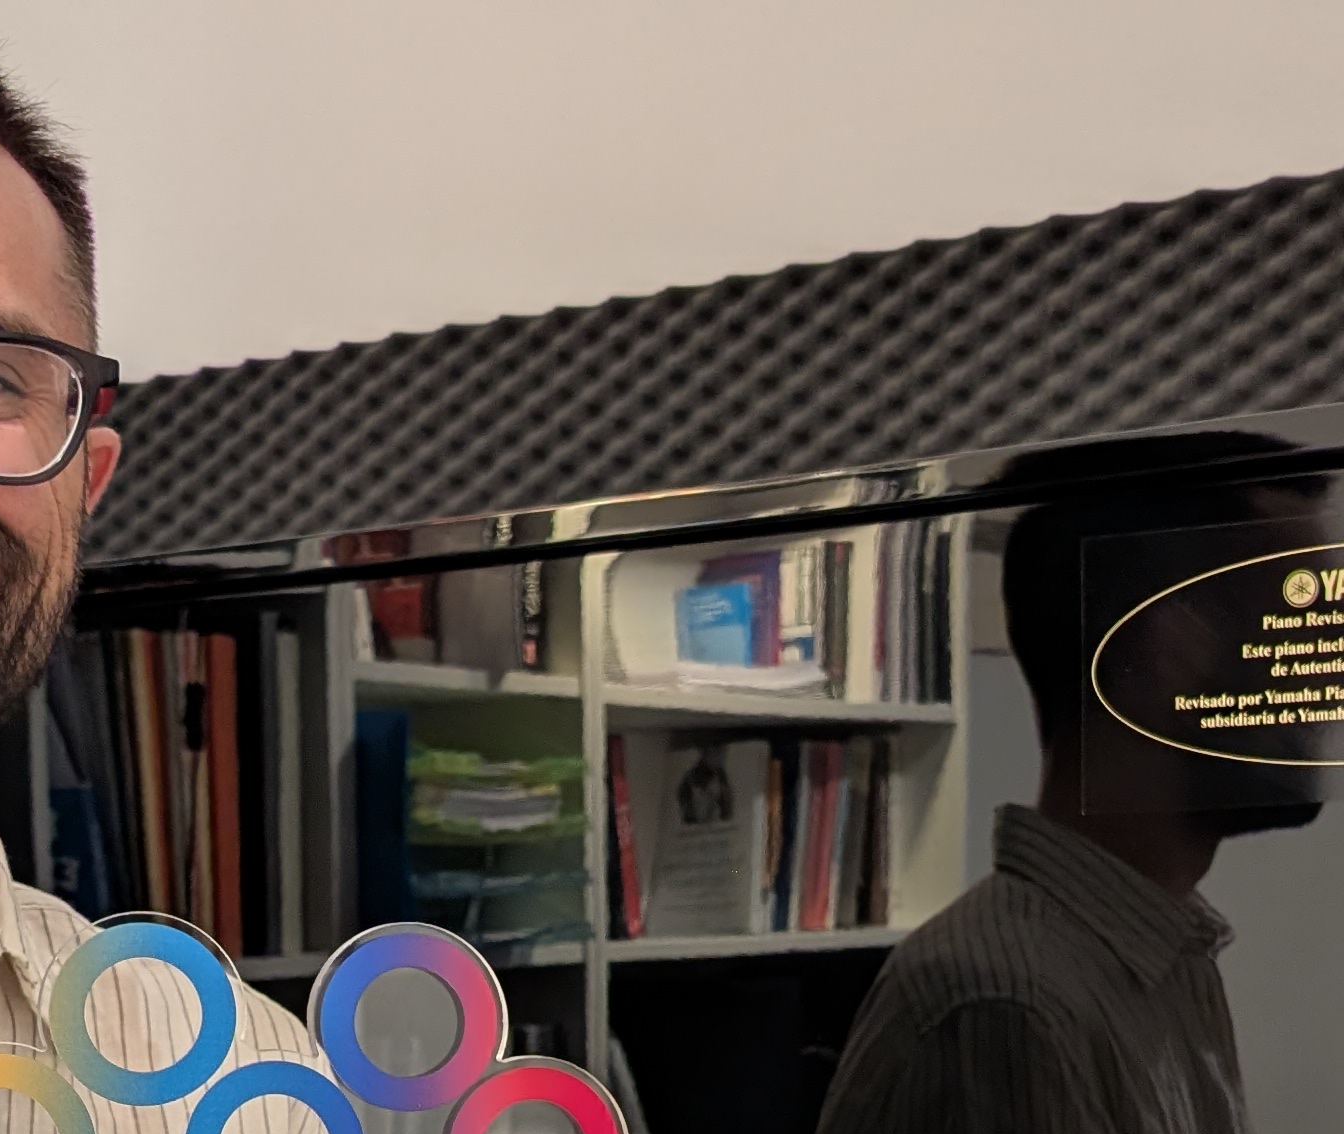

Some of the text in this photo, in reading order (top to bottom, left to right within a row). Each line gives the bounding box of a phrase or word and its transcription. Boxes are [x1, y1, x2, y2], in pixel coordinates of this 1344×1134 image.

[1262, 614, 1303, 630] Piano
[1242, 643, 1272, 659] Este
[1274, 639, 1314, 660] piano
[1270, 661, 1289, 678] de
[1174, 693, 1235, 711] Revisado
[1237, 693, 1263, 710] por
[1265, 687, 1321, 705] Yamaha
[1200, 708, 1276, 729] subsidiaria
[1278, 708, 1296, 724] de
